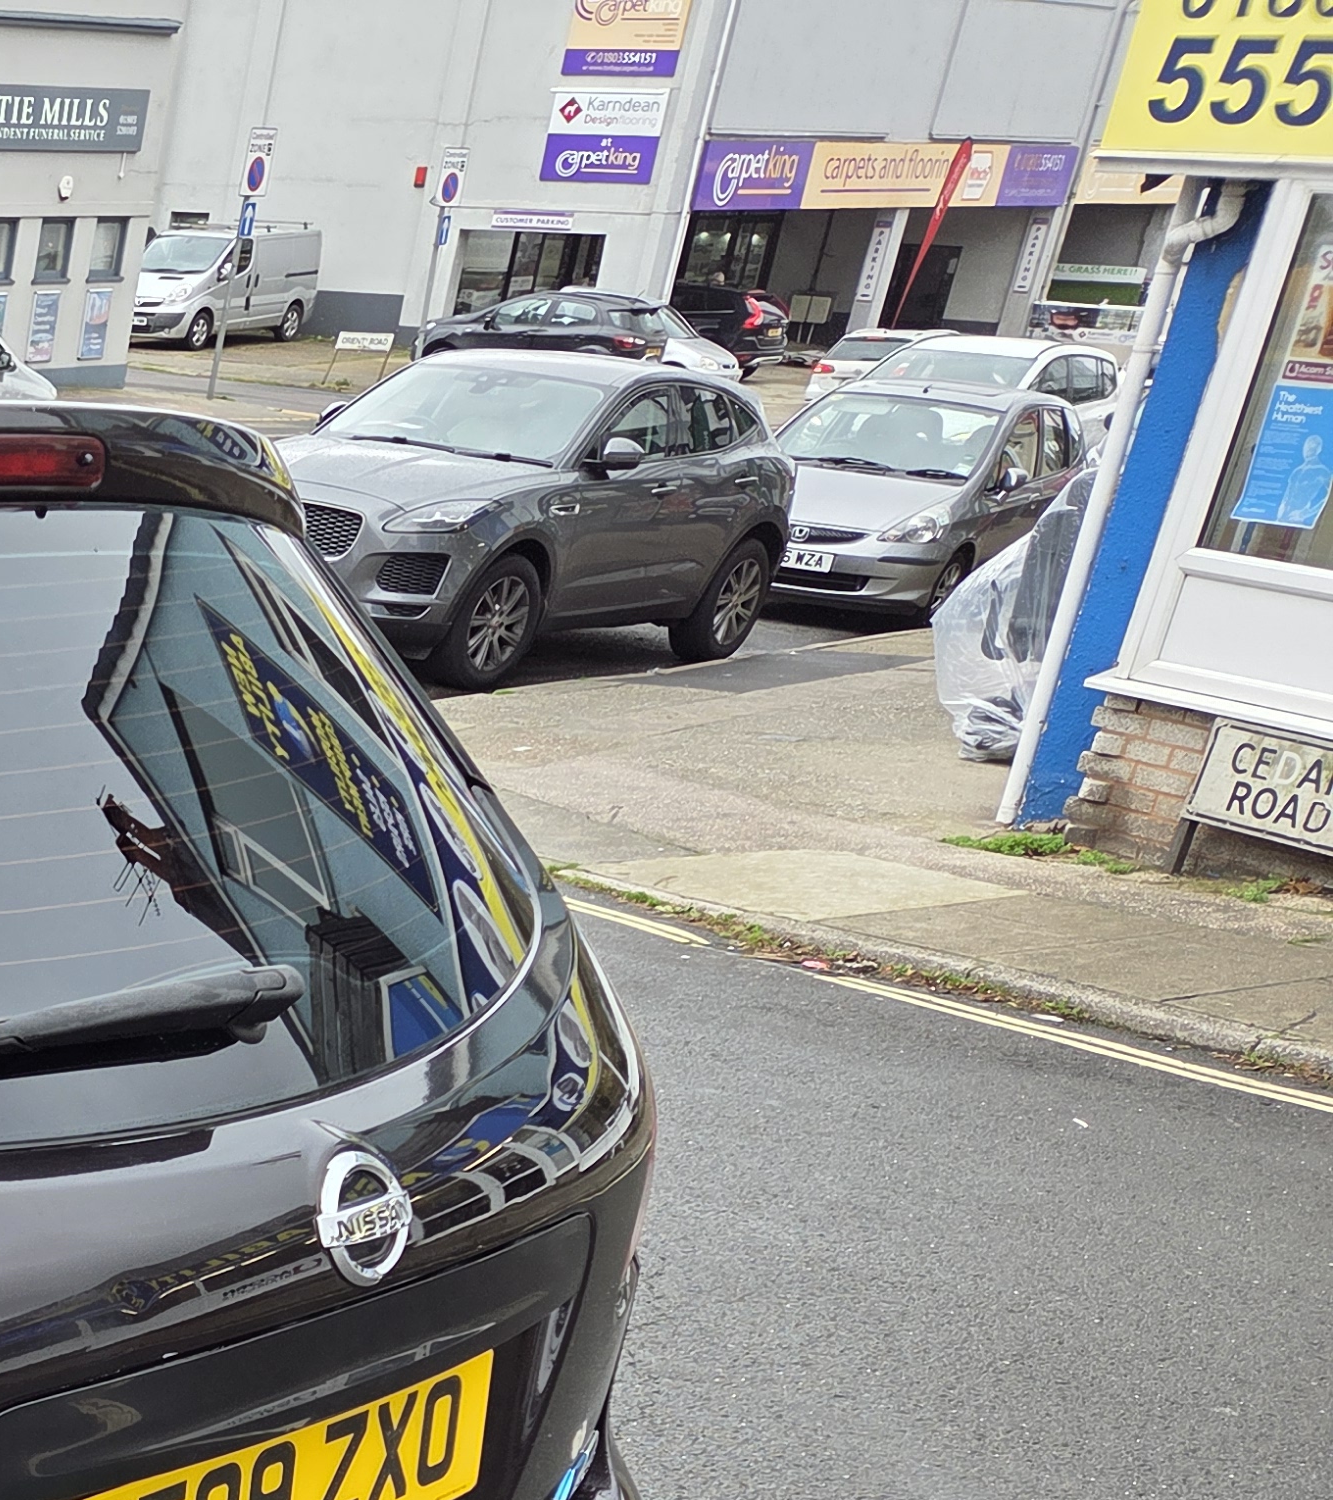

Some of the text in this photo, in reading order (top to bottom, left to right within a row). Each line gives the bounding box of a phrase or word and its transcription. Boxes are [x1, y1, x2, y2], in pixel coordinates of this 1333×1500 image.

[1148, 36, 1333, 127] 555
[39, 97, 110, 127] MILLS
[586, 96, 661, 113] Karndean
[29, 127, 68, 141] FUNERAL
[69, 129, 105, 142] SERVICE
[600, 137, 613, 147] at
[823, 153, 877, 188] carpets
[879, 149, 908, 179] and
[906, 148, 951, 180] floorin
[495, 216, 570, 227] CUSTOMER PARKING
[864, 230, 885, 291] PARKING
[1021, 226, 1042, 282] PARKING
[1068, 265, 1101, 275] GRASS
[1279, 390, 1297, 402] The
[1271, 411, 1307, 424] Human
[795, 551, 823, 569] WZA
[1231, 742, 1333, 796] CEDA
[1225, 780, 1332, 834] ROAD
[336, 1197, 408, 1239] NISSAN
